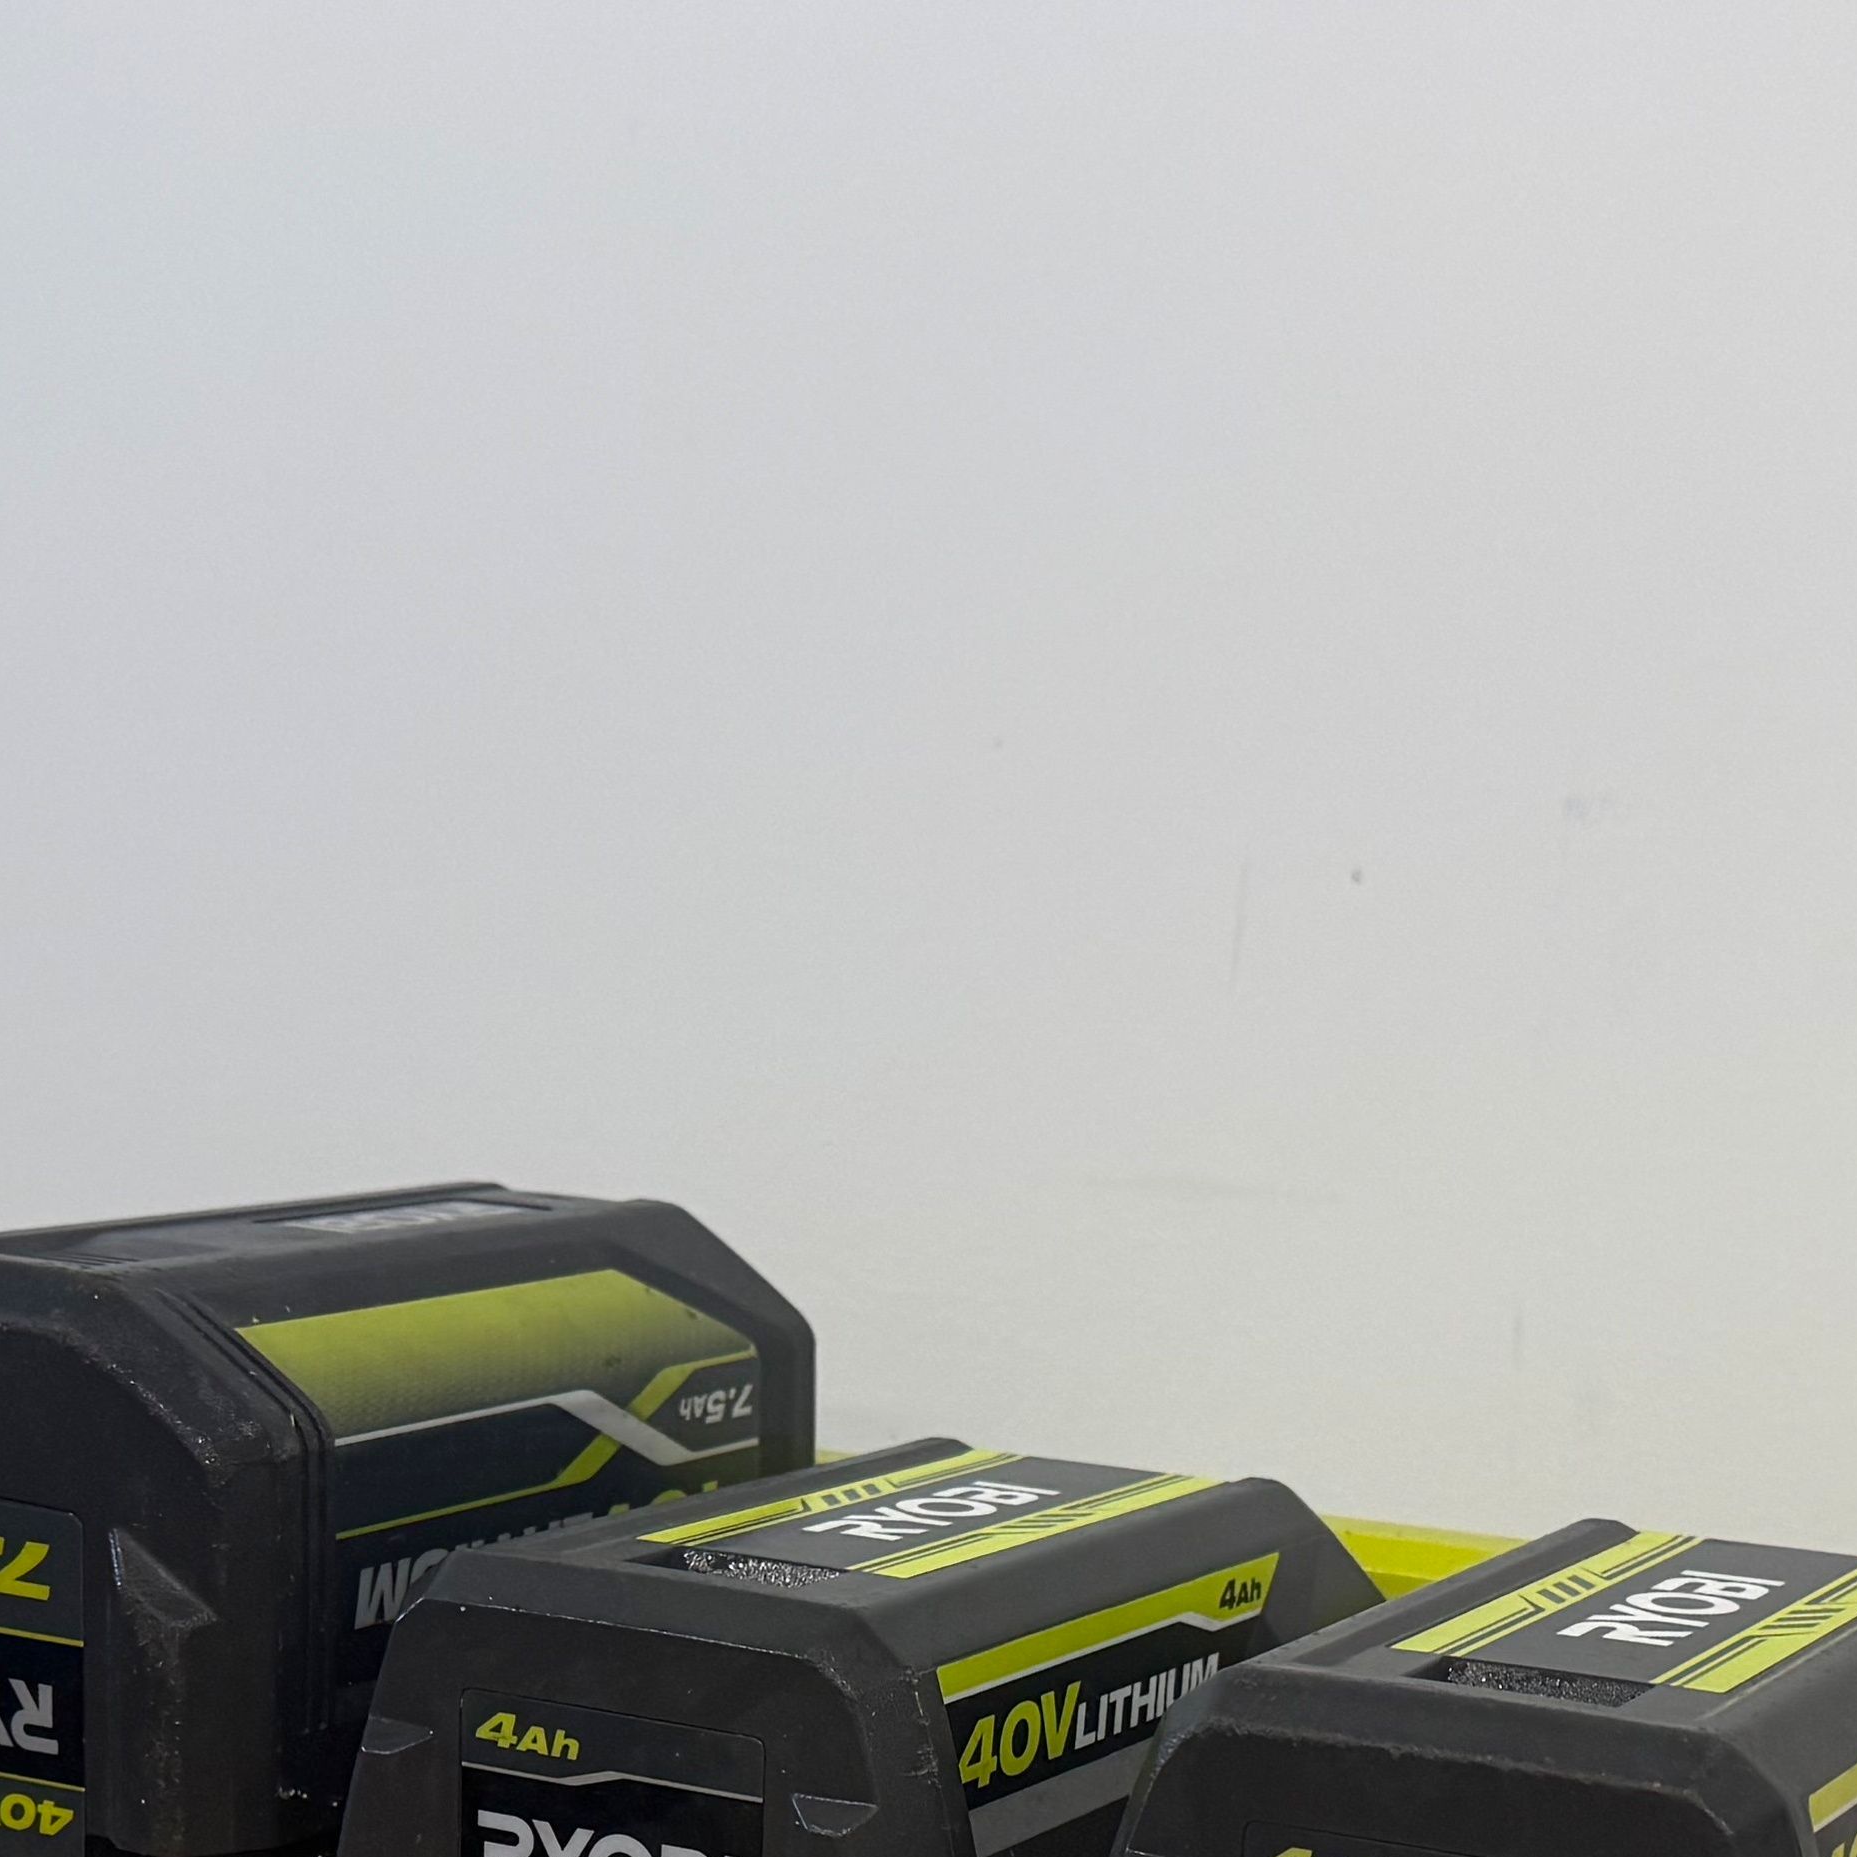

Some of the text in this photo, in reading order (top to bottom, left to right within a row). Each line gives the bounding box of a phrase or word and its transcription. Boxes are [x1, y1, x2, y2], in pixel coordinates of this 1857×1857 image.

[679, 1384, 753, 1424] 7.5Ah
[803, 1481, 1060, 1542] RYOBI
[1218, 1577, 1261, 1611] 4Ah
[1557, 1570, 1786, 1647] RYOBI
[475, 1711, 581, 1761] 4Ah
